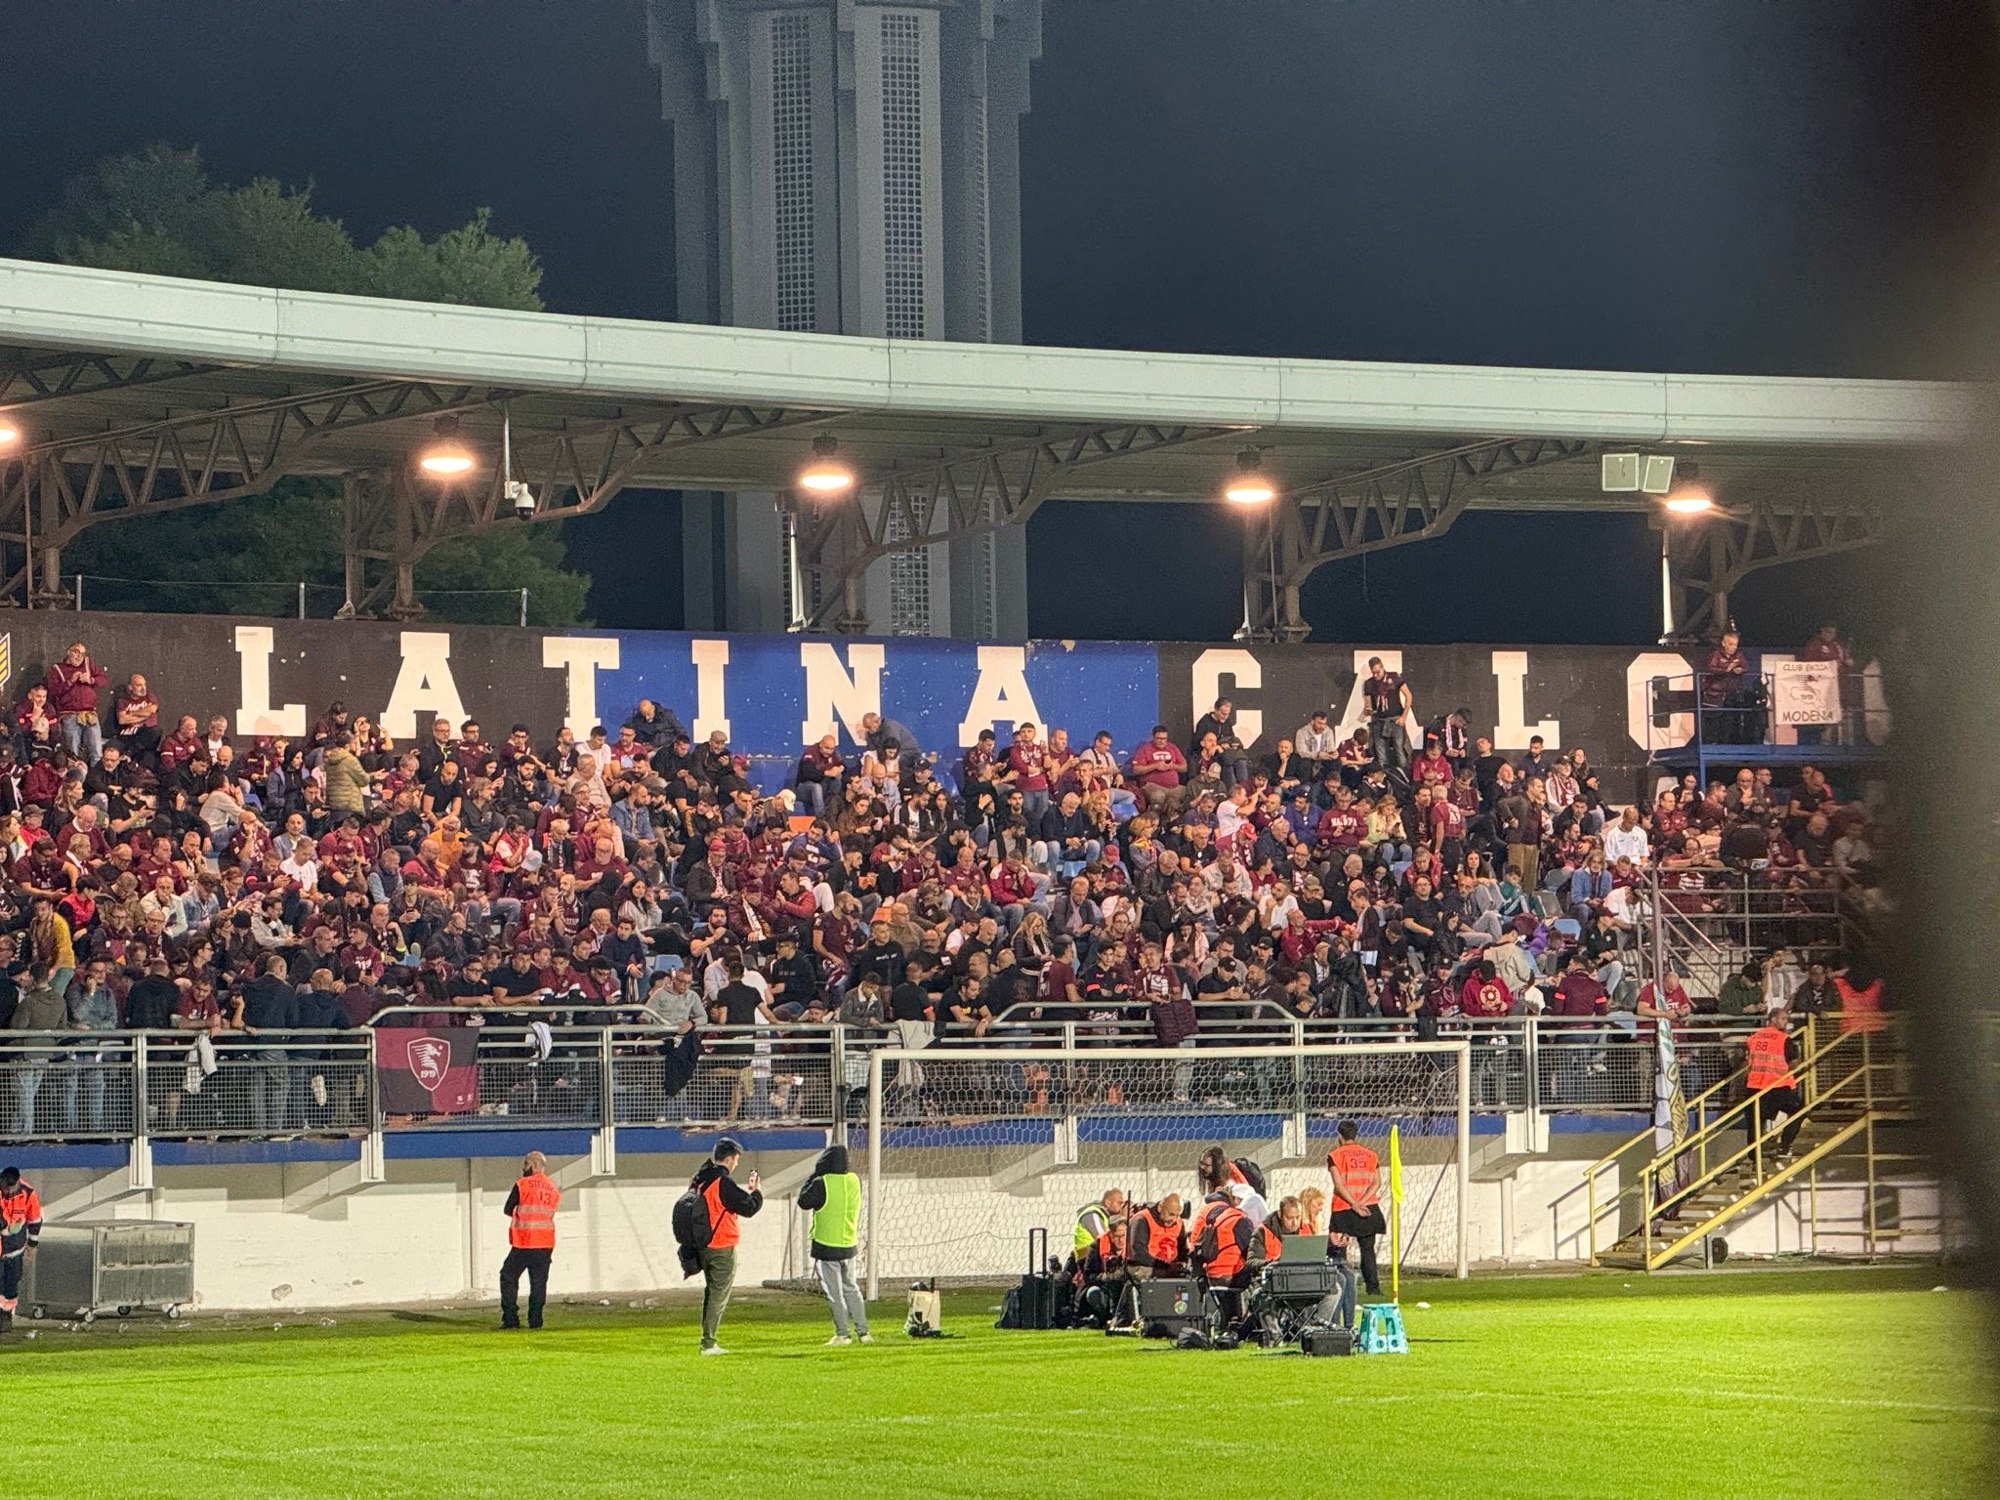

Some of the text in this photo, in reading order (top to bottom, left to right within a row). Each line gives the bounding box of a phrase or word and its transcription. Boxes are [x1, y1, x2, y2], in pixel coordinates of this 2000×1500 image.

[1782, 663, 1803, 672] CLUB
[234, 625, 1049, 748] LATINA
[1782, 710, 1834, 722] MODENA
[1350, 1157, 1367, 1169] 35
